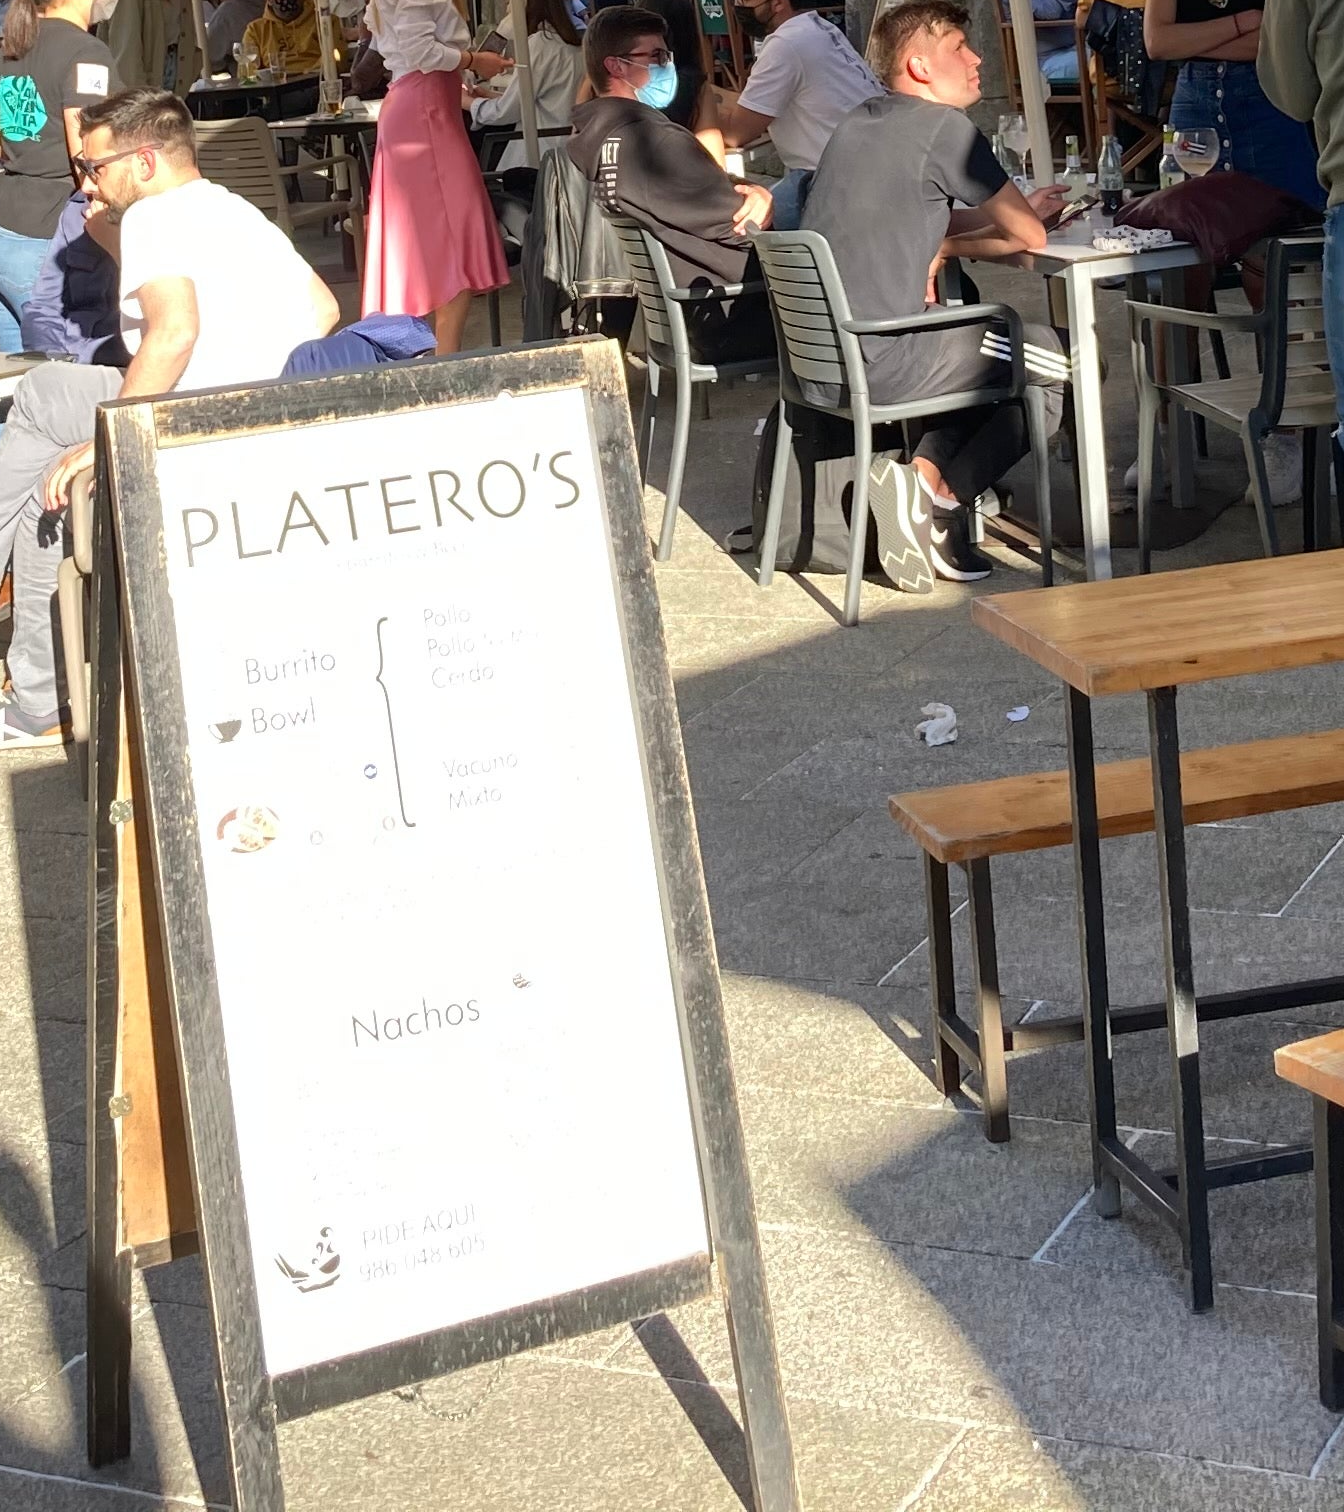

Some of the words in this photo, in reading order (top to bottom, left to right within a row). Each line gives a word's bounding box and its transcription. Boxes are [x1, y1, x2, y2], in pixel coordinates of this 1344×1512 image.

[182, 450, 580, 568] PLATERO'S
[423, 604, 472, 628] Pollo
[427, 635, 476, 659] Pollo
[245, 649, 337, 686] Burrito
[251, 696, 317, 735] Bowl
[442, 751, 519, 779] Vacuno
[448, 785, 503, 812] Mixto
[351, 995, 481, 1047] Nachos
[361, 1219, 417, 1250] PIDE
